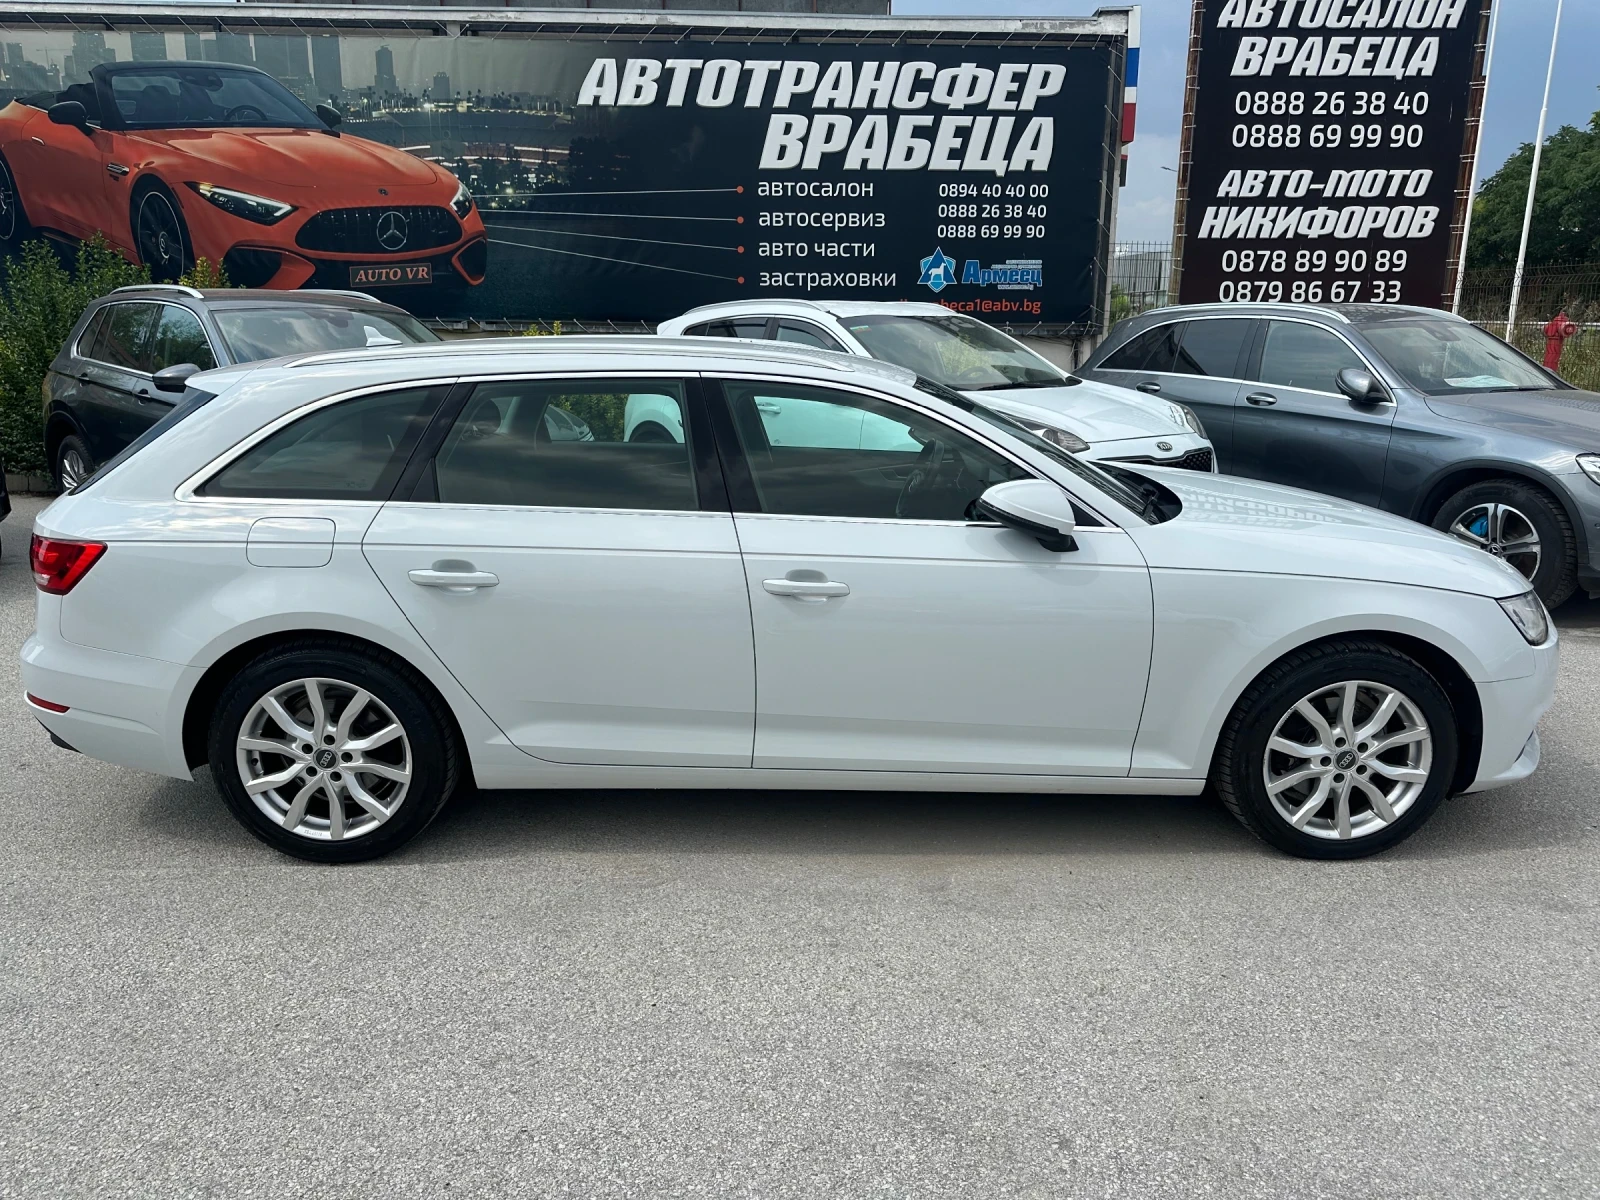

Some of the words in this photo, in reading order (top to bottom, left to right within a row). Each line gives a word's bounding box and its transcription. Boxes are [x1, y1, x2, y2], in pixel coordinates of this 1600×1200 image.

[1216, 0, 1468, 29] АВТОСАЛОН
[1229, 36, 1440, 81] ВРАБЕЦА
[574, 57, 1067, 111] АВТОТРАНСФЕР
[1235, 90, 1305, 115] 0888
[1311, 91, 1345, 115] 26
[1352, 91, 1386, 115] 38
[1393, 91, 1429, 115] 40
[758, 113, 1054, 177] ВРАБЕЦА
[1232, 123, 1302, 148] 0888
[1309, 124, 1342, 148] 69
[1349, 124, 1382, 148] 99
[1389, 124, 1424, 148] 90
[757, 181, 874, 197] автосалон
[938, 183, 978, 198] 0894
[981, 183, 1002, 198] 40
[1005, 184, 1026, 198] 40
[1029, 184, 1049, 198] 00
[1216, 168, 1434, 198] АВТО-МОТО
[758, 211, 886, 232] автосервиз
[938, 204, 978, 218] 0888
[981, 204, 1000, 218] 26
[1003, 204, 1023, 218] 38
[1026, 204, 1047, 218] 40
[1197, 205, 1440, 239] НИКИФОРОВ
[937, 224, 977, 238] 0888
[980, 224, 1000, 239] 69
[1003, 224, 1022, 239] 99
[1026, 224, 1045, 239] 90
[758, 242, 808, 257] авто
[814, 242, 875, 257] части
[1221, 249, 1287, 273] 0878
[1294, 249, 1327, 273] 89
[1334, 249, 1367, 273] 90
[1374, 249, 1408, 272] 89
[354, 268, 403, 283] AUTO
[406, 266, 429, 279] VR
[759, 272, 896, 291] застраховки
[961, 259, 1043, 287] Армеец
[1219, 280, 1283, 303] 0879
[1290, 280, 1323, 303] 86
[1330, 280, 1362, 303] 67
[1370, 280, 1402, 303] 33
